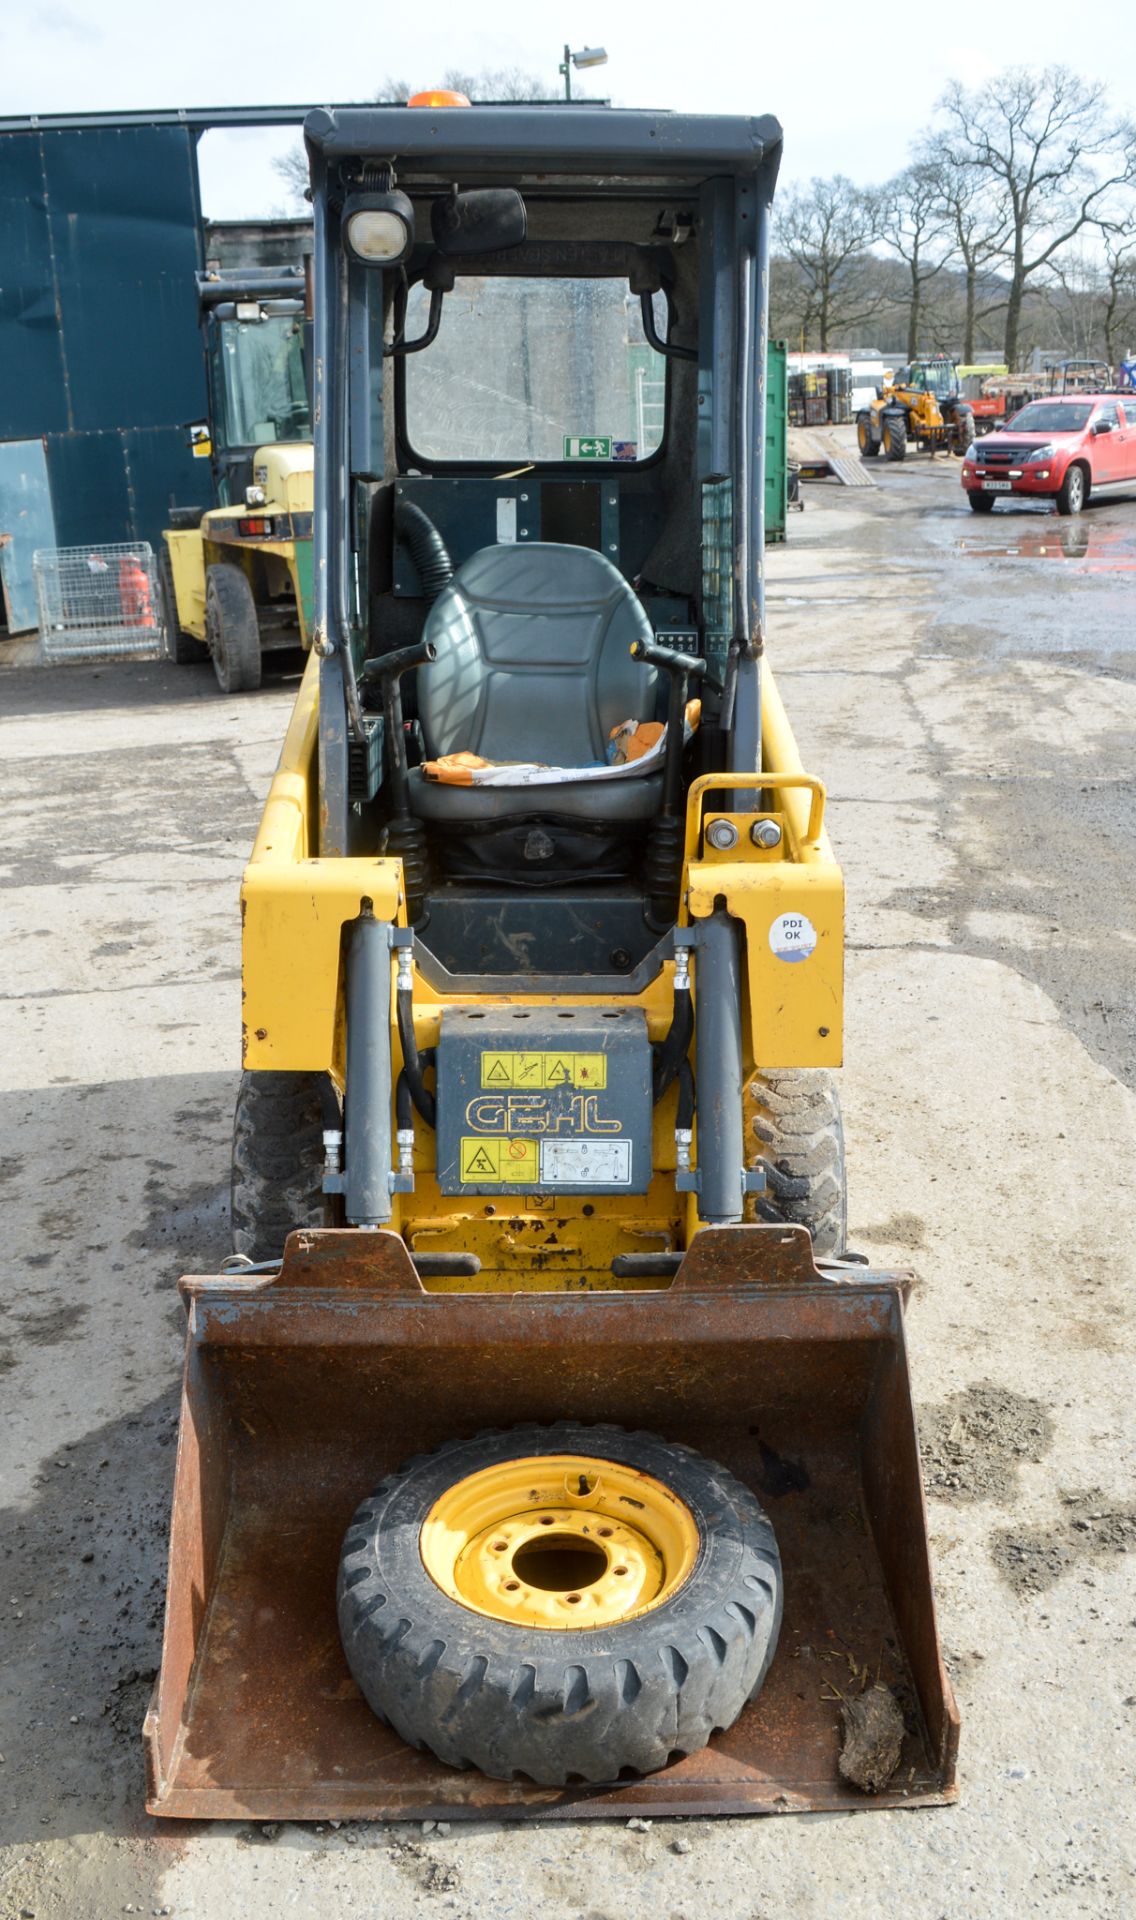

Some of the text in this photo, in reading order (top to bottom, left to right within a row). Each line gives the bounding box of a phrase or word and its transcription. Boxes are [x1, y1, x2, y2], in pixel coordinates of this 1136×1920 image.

[783, 920, 803, 928] PDI
[785, 931, 801, 940] OK
[465, 1095, 623, 1133] GEHL
